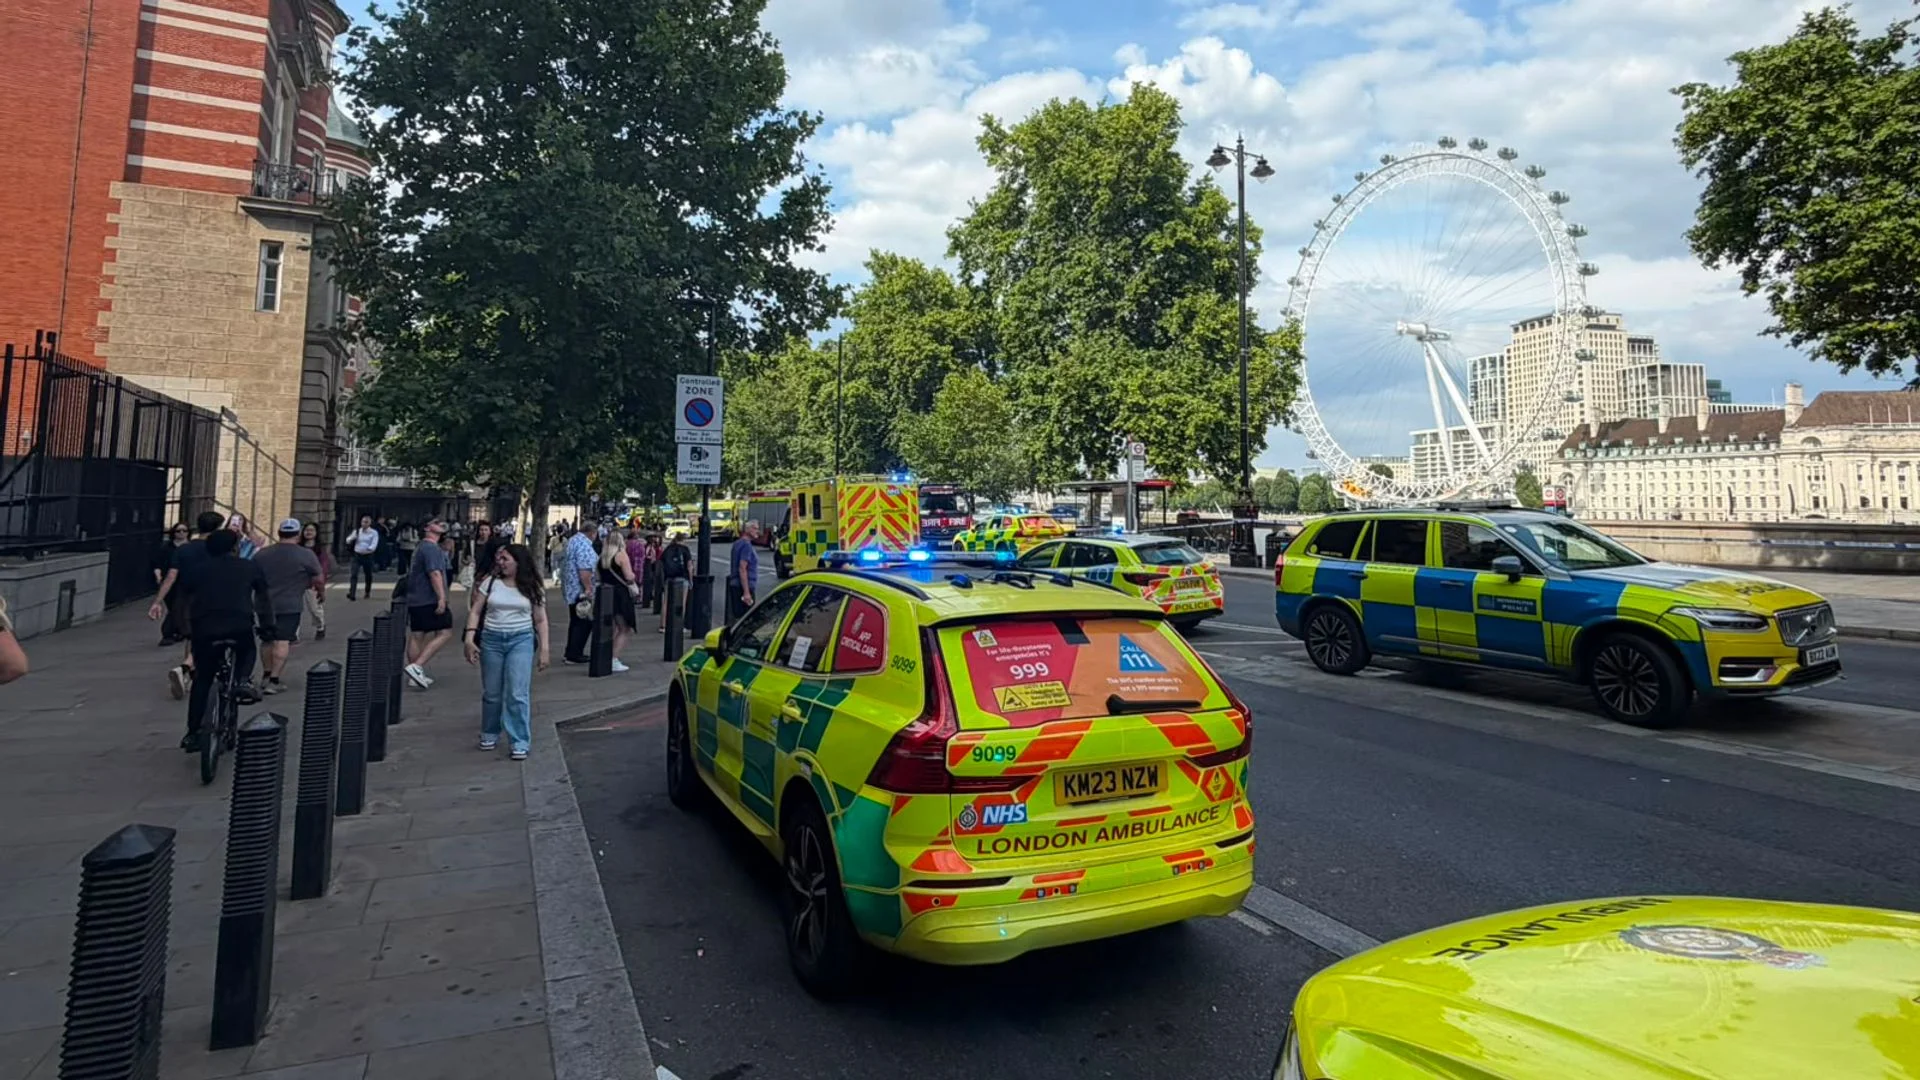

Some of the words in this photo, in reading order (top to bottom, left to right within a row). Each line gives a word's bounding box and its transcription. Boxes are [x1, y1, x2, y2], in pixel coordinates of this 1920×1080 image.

[685, 386, 714, 395] ZONE
[1175, 601, 1210, 611] POLICE
[858, 631, 872, 642] APP
[840, 636, 862, 653] CRITICAL
[861, 644, 878, 658] CARE
[1120, 645, 1142, 653] CALL
[891, 655, 916, 674] 9099
[996, 651, 1038, 661] emergencies
[1122, 653, 1154, 668] 111
[1009, 662, 1050, 680] 999
[973, 745, 1017, 762] 9099
[1063, 770, 1118, 798] KM23
[1122, 765, 1159, 791] NZW
[982, 803, 1026, 825] NHS
[976, 829, 1088, 855] LONDON
[1095, 805, 1221, 843] AMBULANCE
[1433, 897, 1672, 961] AMBULANCE
